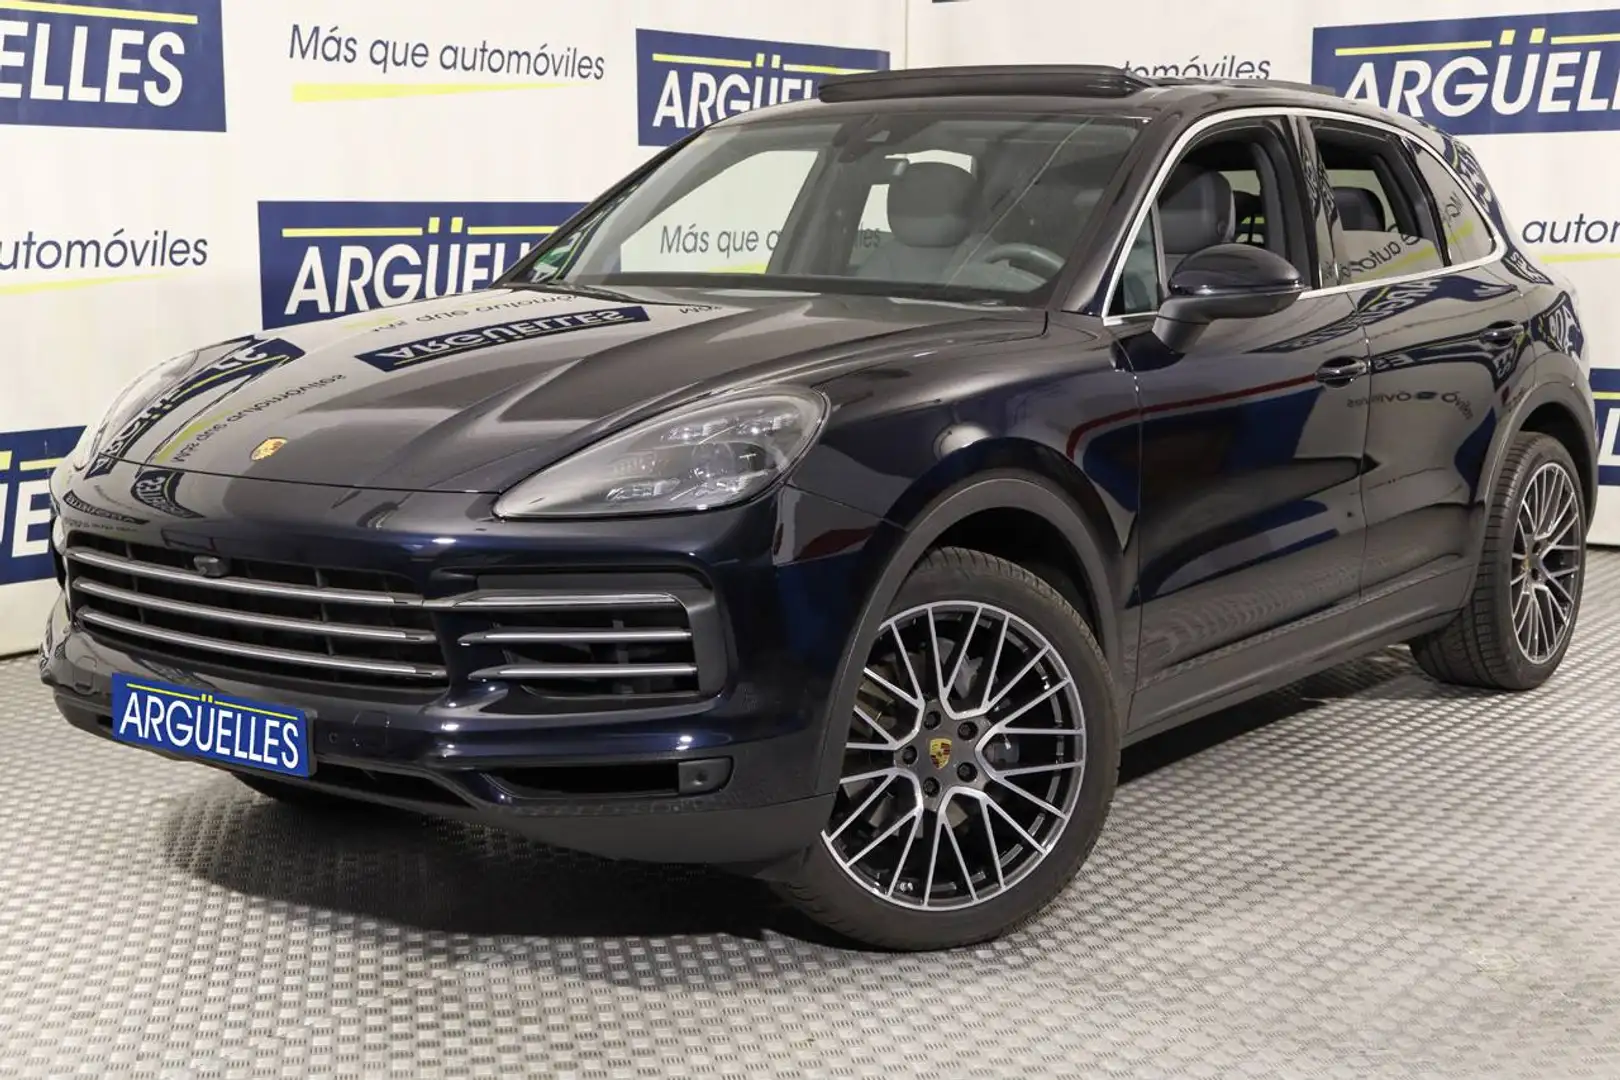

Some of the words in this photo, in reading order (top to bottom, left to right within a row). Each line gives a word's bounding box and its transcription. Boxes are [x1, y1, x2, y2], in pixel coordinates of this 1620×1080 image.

[0, 20, 185, 107] ELLES
[289, 24, 358, 63] Más
[369, 39, 429, 74] que
[439, 40, 605, 80] automóviles
[1343, 28, 1620, 118] ARGÜEL
[660, 223, 710, 254] Más
[717, 230, 759, 258] que
[118, 691, 299, 769] ARGÜELLES
